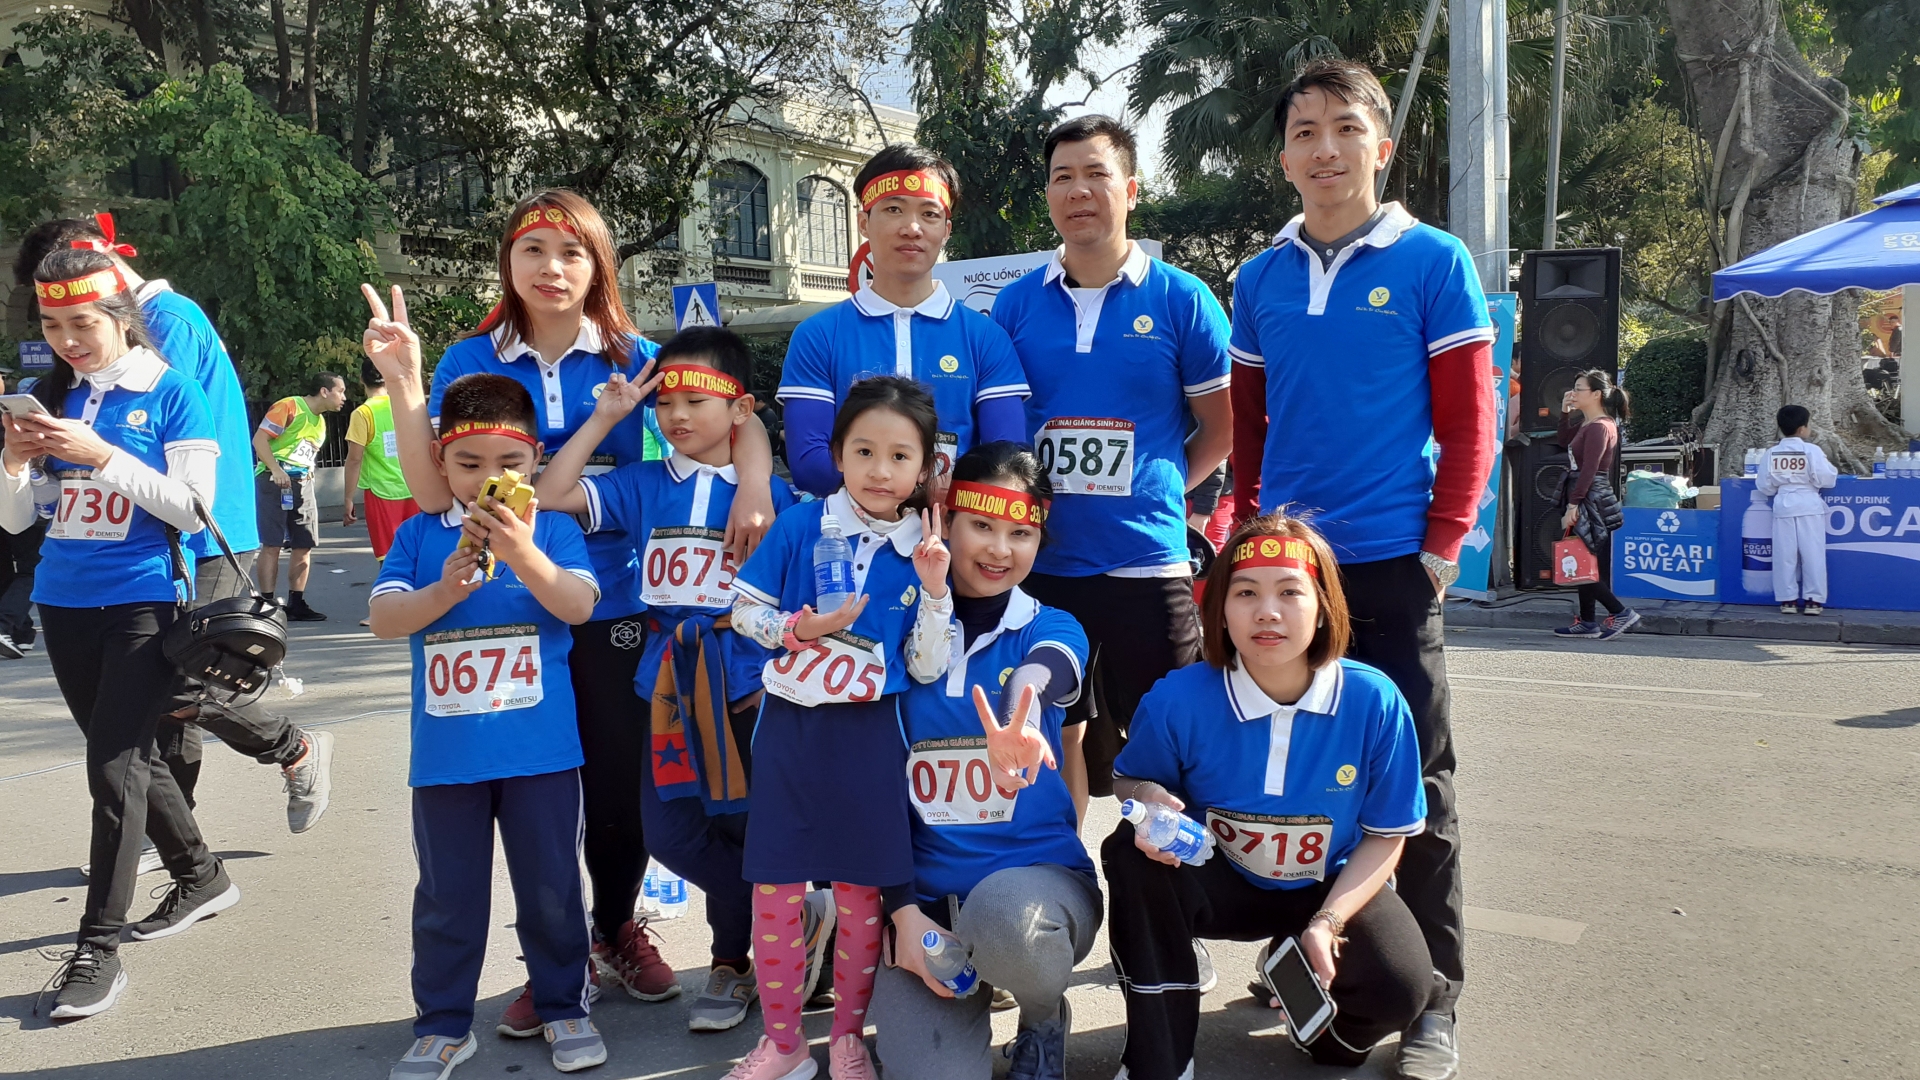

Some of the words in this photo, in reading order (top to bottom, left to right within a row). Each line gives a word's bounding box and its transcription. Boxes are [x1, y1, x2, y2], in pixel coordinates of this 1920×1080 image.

[963, 270, 991, 283] NƯỚC
[993, 266, 1022, 280] UỐNG
[1073, 418, 1096, 426] GIÁNG
[1039, 437, 1129, 477] 0587
[1772, 457, 1806, 471] 1089
[1096, 484, 1125, 492] IDEMITSU
[57, 487, 130, 525] 730
[955, 489, 1007, 516] MOTTAINAI
[1855, 495, 1891, 504] DRINK
[1624, 541, 1713, 560] POCARI
[647, 546, 738, 591] 0675
[1623, 555, 1704, 573] SWEAT
[428, 645, 538, 697] 0674
[771, 680, 797, 696] TOYOTA
[438, 702, 461, 711] TOYOTA
[503, 695, 538, 706] IDEMITSU
[1210, 818, 1325, 866] 0718
[1220, 843, 1245, 862] TOYOTA
[1283, 869, 1319, 878] IDEMITSU
